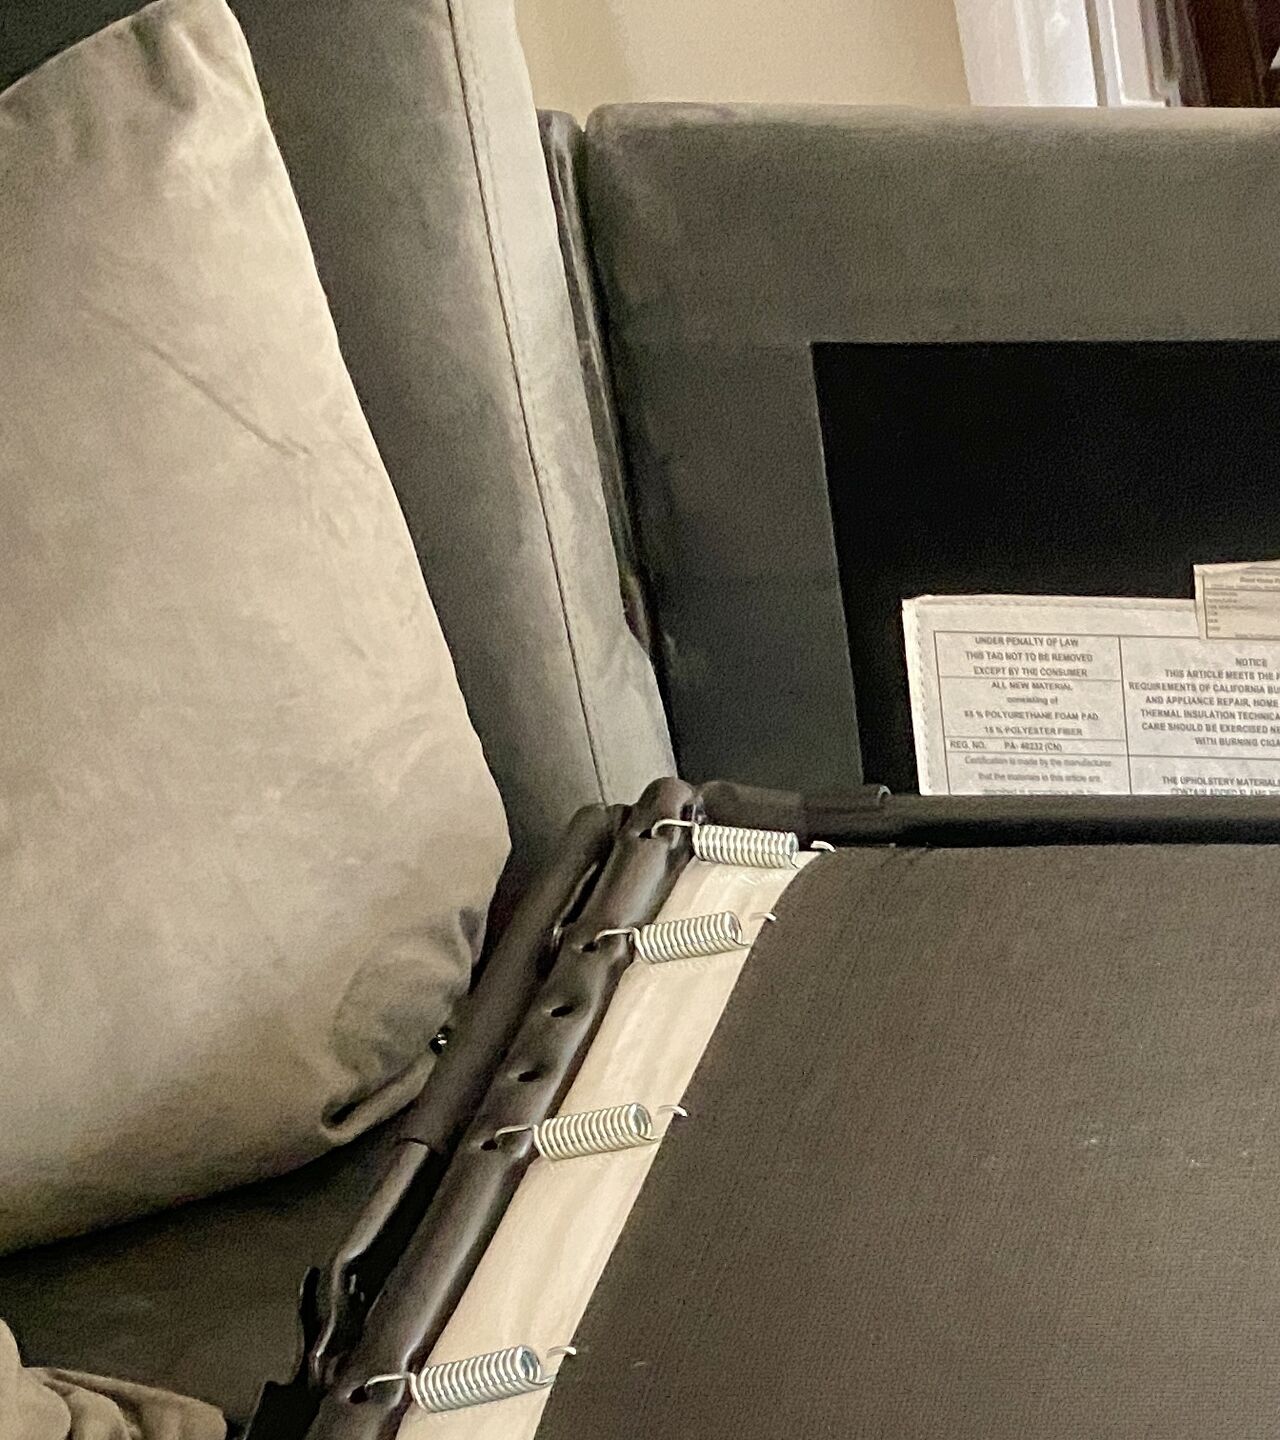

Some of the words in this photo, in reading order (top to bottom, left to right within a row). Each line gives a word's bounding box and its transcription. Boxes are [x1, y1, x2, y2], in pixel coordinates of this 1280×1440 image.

[976, 637, 1004, 646] UNDER
[1006, 637, 1043, 646] PENALTY
[1047, 638, 1057, 647] OF
[1060, 638, 1078, 647] LAW
[966, 652, 984, 660] THIS
[1006, 652, 1022, 661] NOT
[1025, 652, 1036, 661] TO
[1039, 653, 1050, 661] BE
[1052, 653, 1093, 662] REMOVED
[1236, 658, 1268, 667] NOTICE
[974, 667, 1005, 676] EXCEPT
[1008, 667, 1020, 676] BY
[1022, 667, 1037, 676] THE
[1040, 667, 1087, 677] CONSUMER
[1165, 670, 1184, 679] THIS
[1187, 670, 1223, 680] ARTICLE
[1226, 671, 1254, 680] MEETS
[1258, 671, 1274, 681] THE
[1010, 682, 1029, 690] NEW
[1032, 682, 1073, 691] MATERIAL
[1128, 682, 1196, 692] REQUIREMENTS
[1199, 683, 1210, 693] OF
[1213, 684, 1264, 694] CALIFORNIA
[1050, 696, 1058, 704] of
[1146, 696, 1164, 705] AND
[1166, 697, 1214, 706] APPLIANCE
[1217, 698, 1250, 707] REPAIR,
[1254, 699, 1278, 708] HOME
[986, 711, 1052, 720] POLYURETHANE
[1055, 712, 1078, 720] FOAM
[1082, 712, 1098, 720] PAD
[1142, 710, 1181, 719] THERMAL
[1184, 711, 1236, 721] INSULATION
[1006, 727, 1056, 735] POLYESTER
[1142, 722, 1166, 731] CARE
[1168, 723, 1202, 732] SHOULD
[1206, 724, 1217, 733] BE
[1220, 725, 1268, 734] EXERCISED
[1195, 737, 1217, 746] WITH
[1220, 737, 1258, 747] BURNING
[1162, 776, 1177, 784] THE
[1180, 776, 1234, 786] UPHOLSTERY
